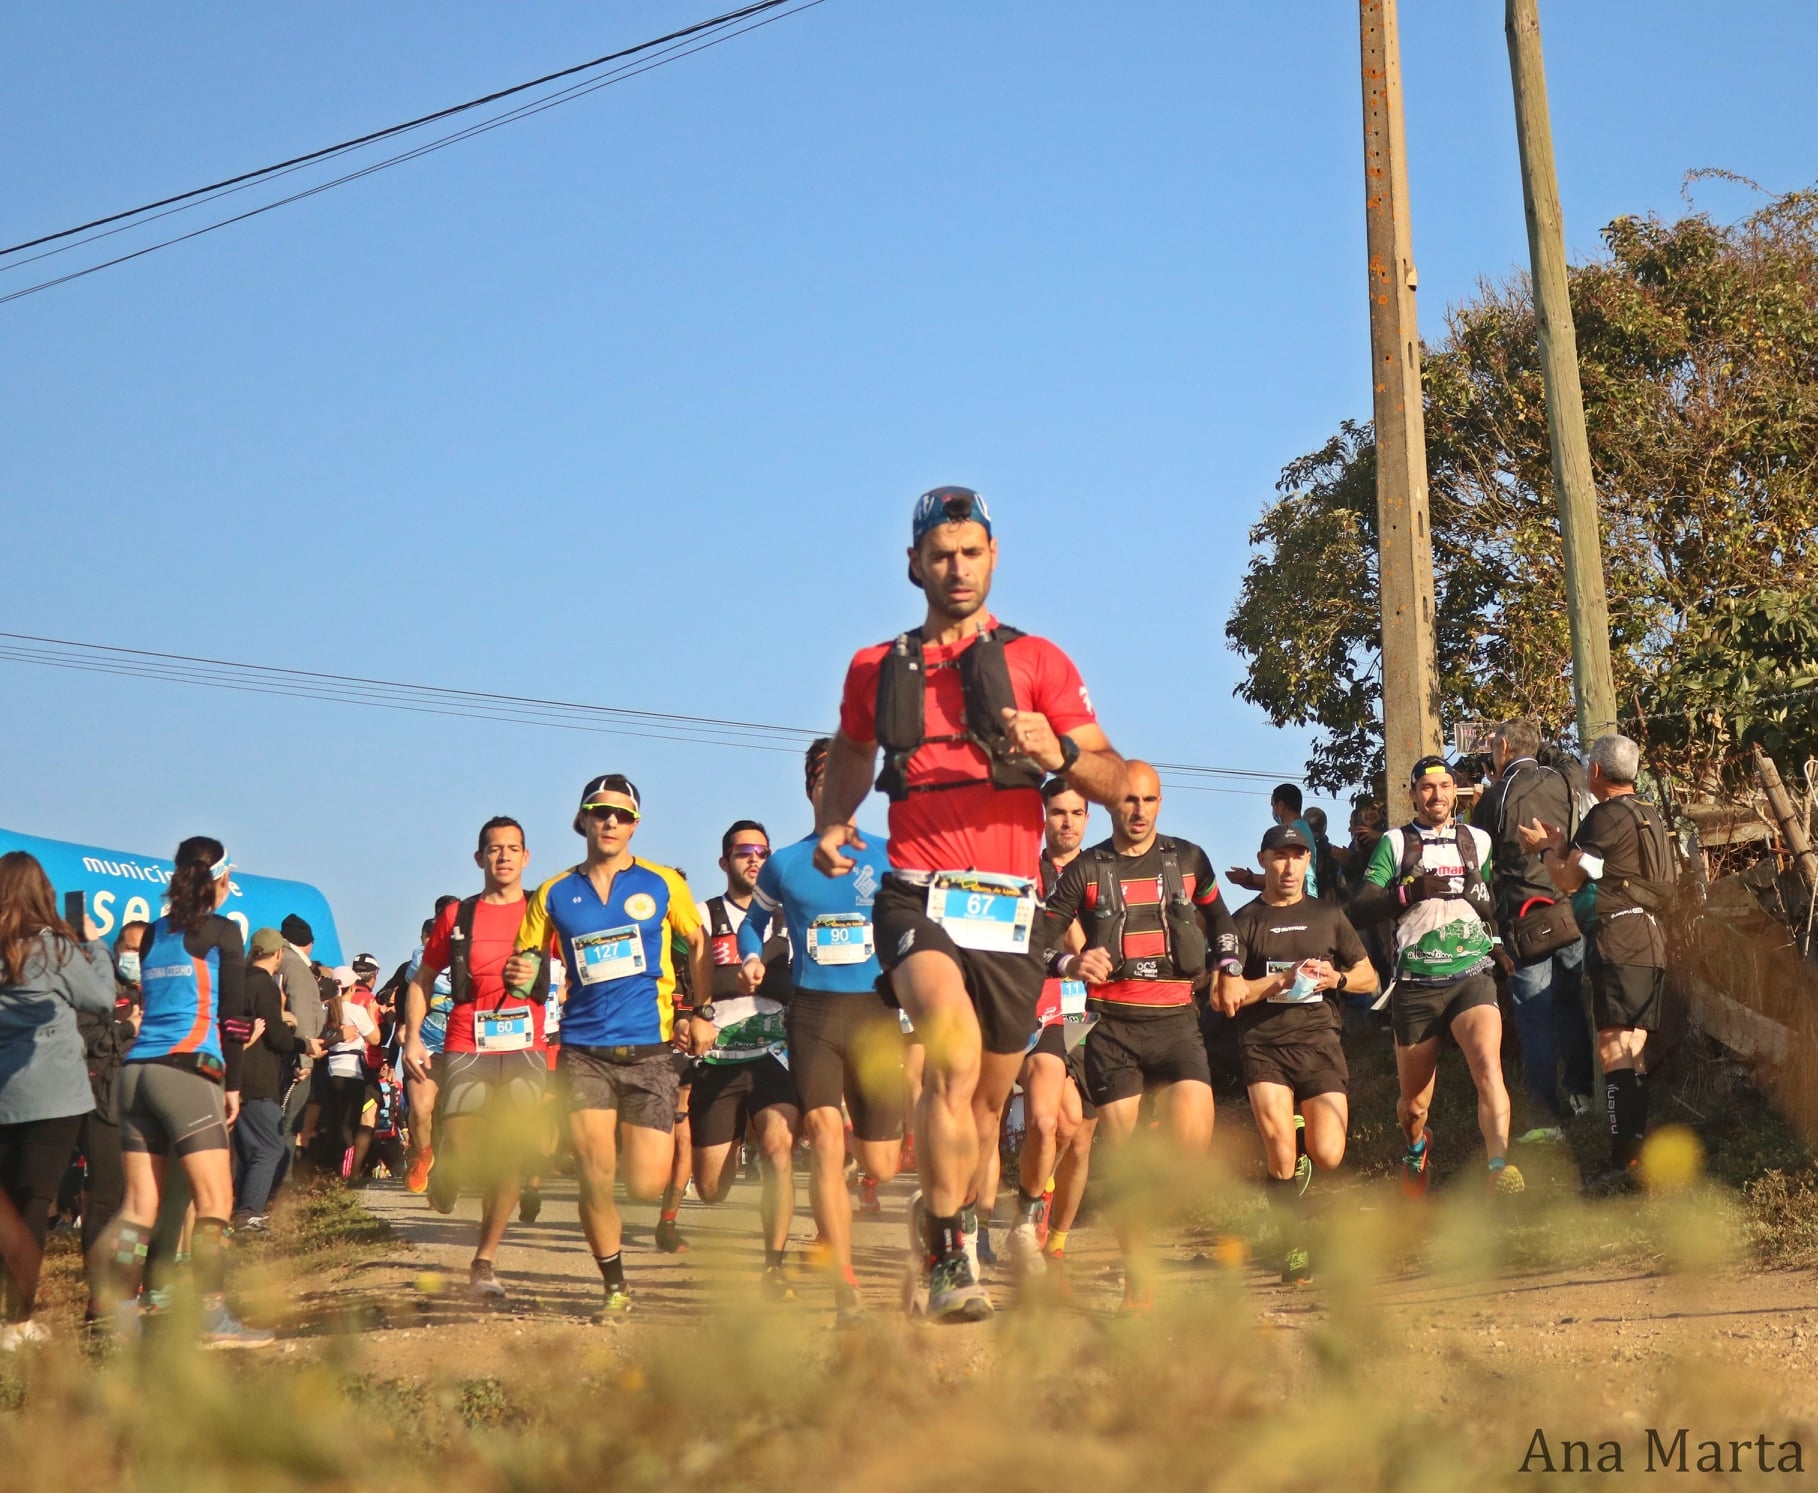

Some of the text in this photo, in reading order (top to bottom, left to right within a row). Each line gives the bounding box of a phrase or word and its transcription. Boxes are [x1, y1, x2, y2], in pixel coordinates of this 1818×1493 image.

[966, 893, 997, 915] 67
[830, 927, 850, 942] 90
[593, 942, 620, 960] 127
[496, 1020, 513, 1034] 60
